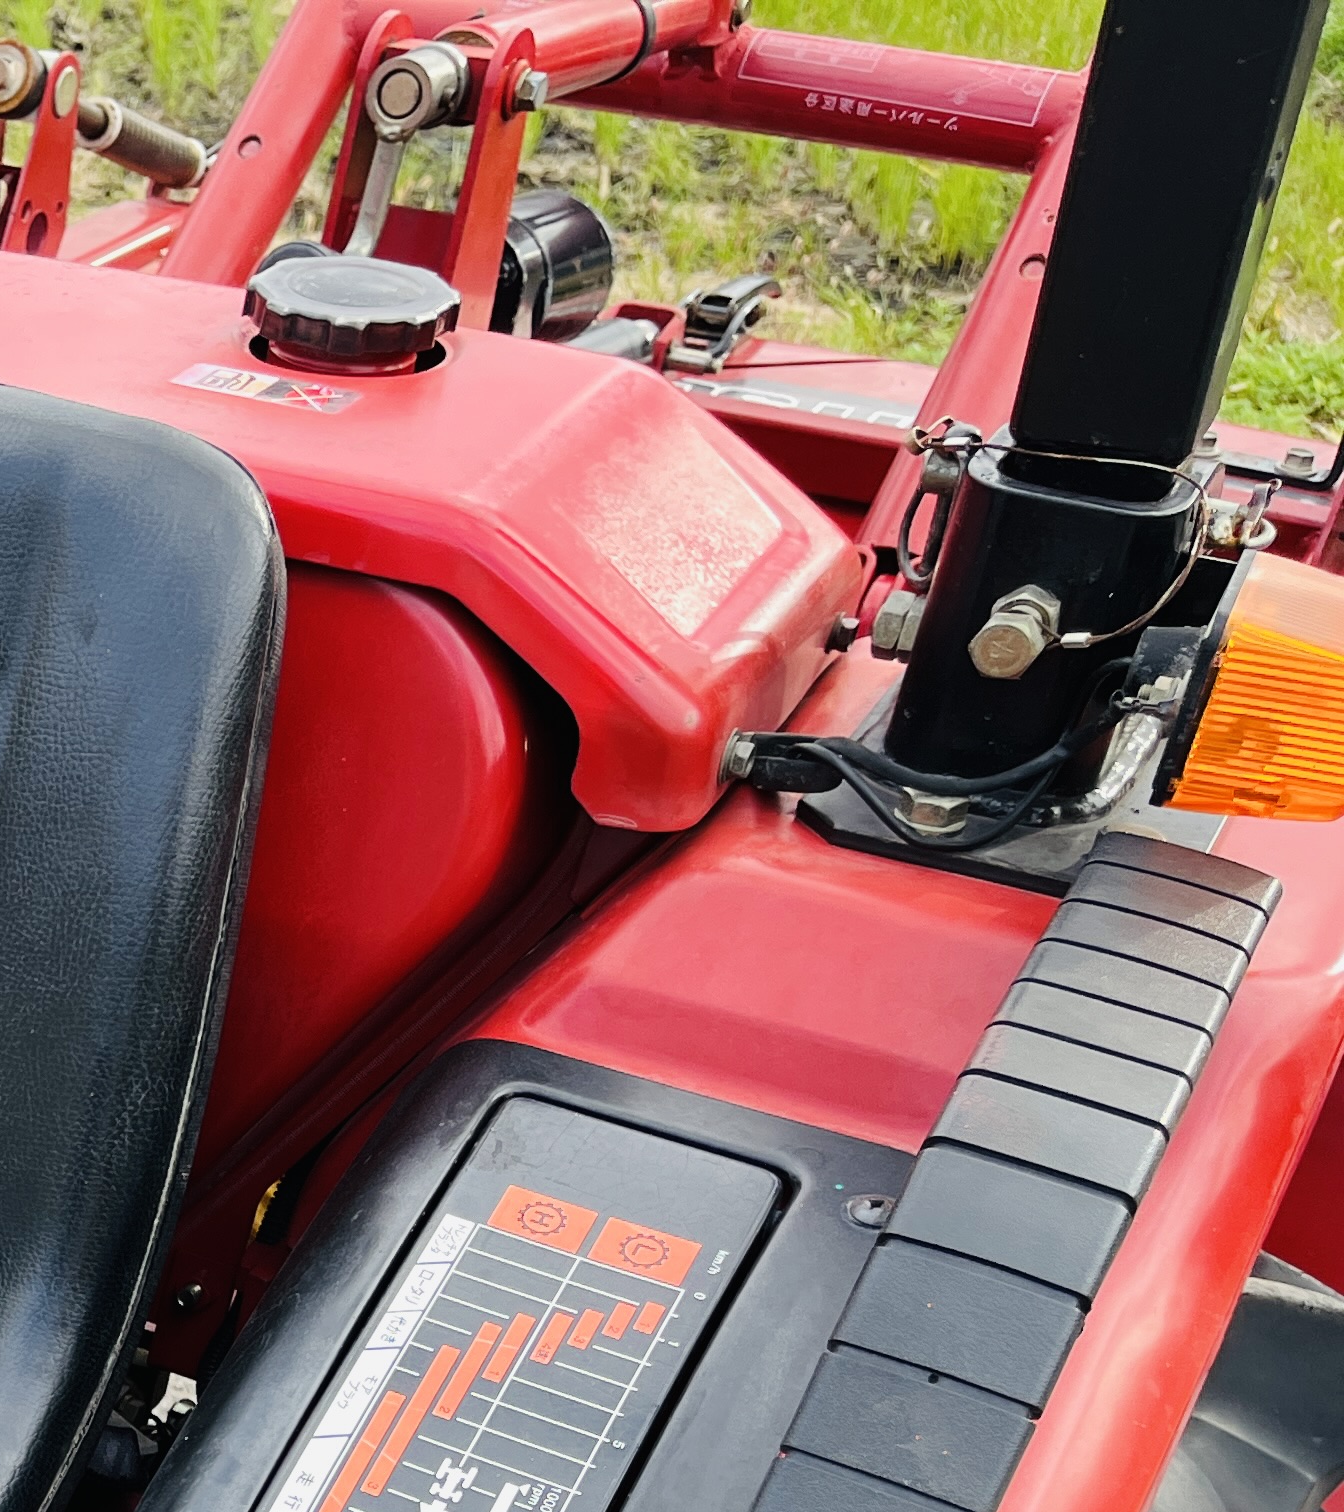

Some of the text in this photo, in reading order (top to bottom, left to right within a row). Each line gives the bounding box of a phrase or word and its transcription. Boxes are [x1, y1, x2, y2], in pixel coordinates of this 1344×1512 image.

[707, 1249, 731, 1275] km/h
[405, 1268, 434, 1305] ロータリ
[693, 1291, 707, 1301] 0
[381, 1315, 408, 1344] 代かき
[609, 1325, 620, 1334] 2
[573, 1335, 585, 1345] 3
[667, 1340, 680, 1348] 1
[439, 1405, 451, 1414] 2
[613, 1439, 626, 1450] 5
[367, 1481, 380, 1491] 3
[527, 1483, 545, 1506] rpm
